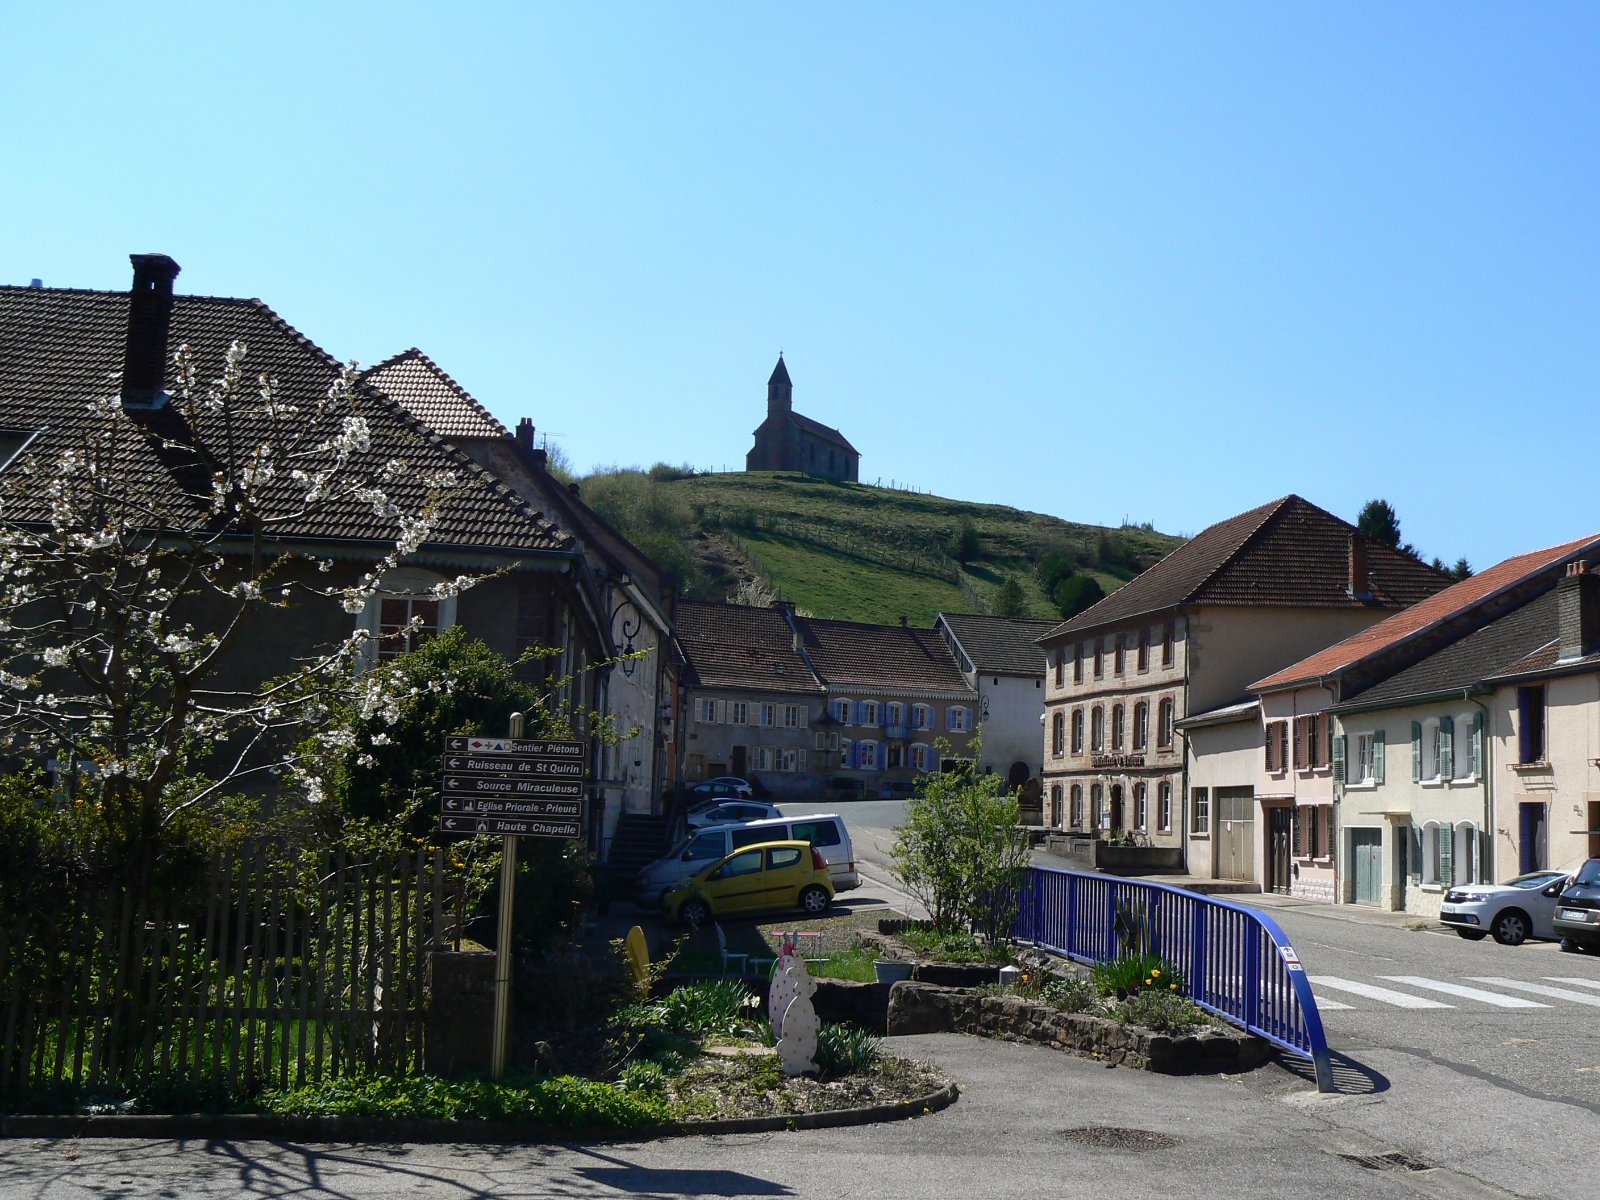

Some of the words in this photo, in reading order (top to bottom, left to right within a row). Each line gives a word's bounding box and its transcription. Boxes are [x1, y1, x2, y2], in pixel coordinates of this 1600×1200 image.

[512, 742, 543, 753] Sentier
[547, 743, 580, 754] Piétons
[467, 760, 513, 771] Ruisseau
[519, 763, 531, 772] de
[536, 763, 547, 772] St
[550, 764, 580, 774] Quirin
[477, 780, 512, 790] Source
[517, 782, 579, 794] Miraculeuse
[477, 801, 503, 813] Eglise
[505, 803, 539, 812] Priorale
[546, 803, 578, 814] Prieuré
[497, 821, 527, 832] Haute
[533, 823, 576, 835] Chapelle
